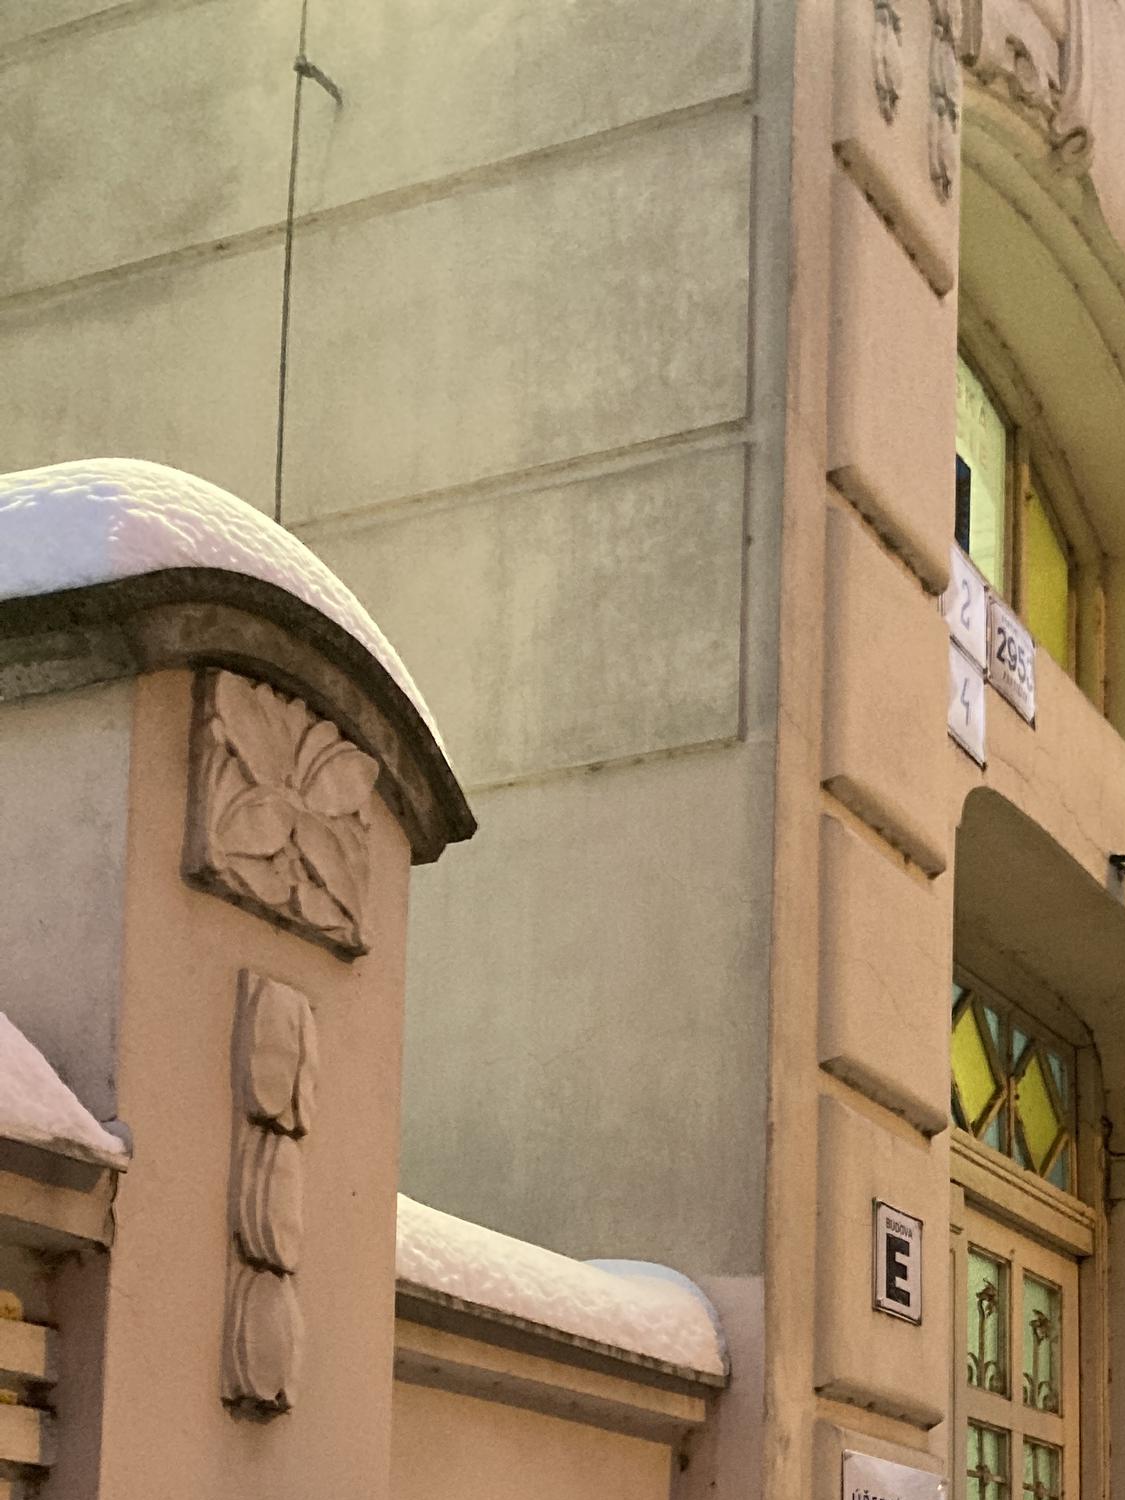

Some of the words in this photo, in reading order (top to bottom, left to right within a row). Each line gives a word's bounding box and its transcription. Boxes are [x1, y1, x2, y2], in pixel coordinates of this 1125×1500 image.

[960, 578, 971, 631] 2
[960, 678, 971, 726] 4
[886, 1233, 910, 1307] E
